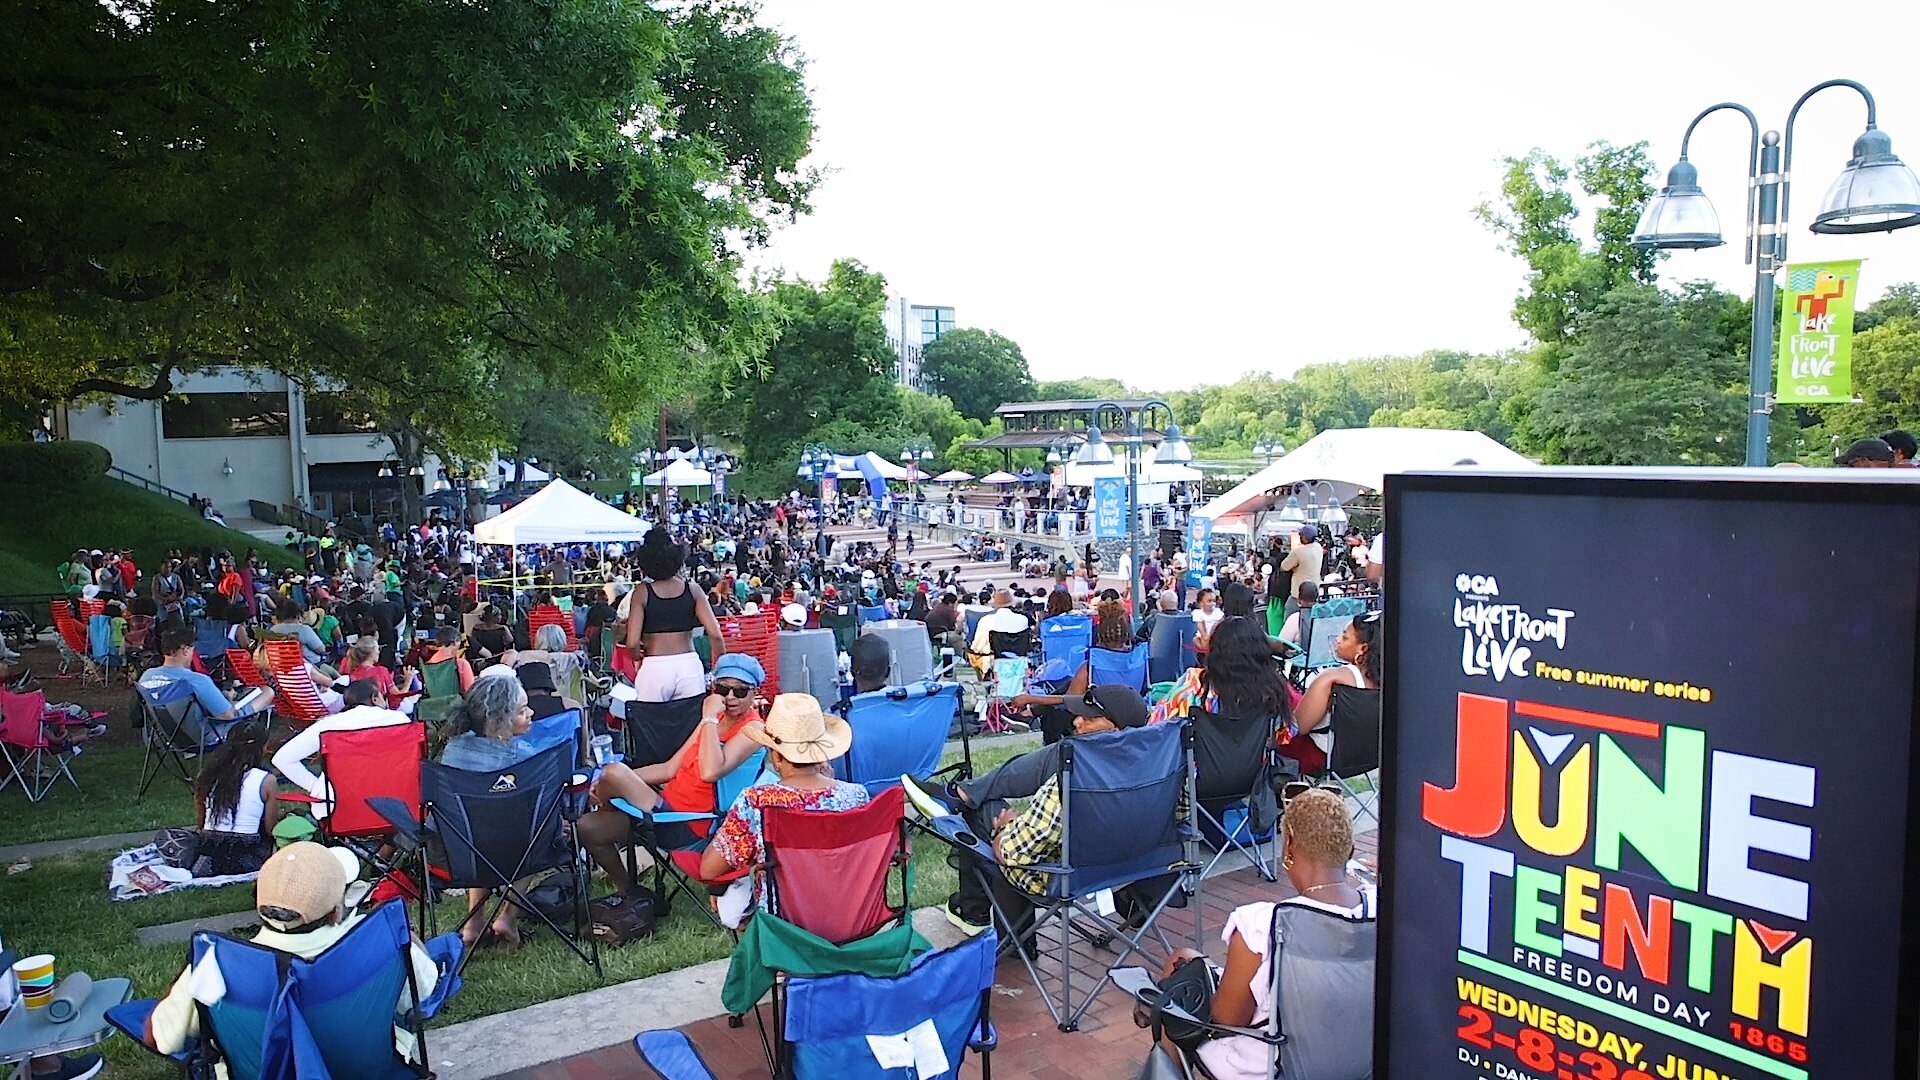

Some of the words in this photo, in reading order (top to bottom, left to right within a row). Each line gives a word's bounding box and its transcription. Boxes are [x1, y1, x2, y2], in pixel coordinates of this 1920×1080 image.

[1536, 661, 1572, 682] Free
[1576, 670, 1650, 693] summer
[1654, 681, 1711, 702] series
[1422, 692, 1816, 921] JUNE
[1441, 835, 1813, 1037] TEENTH
[1457, 977, 1647, 1072] WEDNESDAY,
[1514, 947, 1638, 1004] FREEDOM
[1653, 993, 1711, 1027] DAY
[1457, 1004, 1656, 1080] 2-8:3
[1458, 1047, 1479, 1067] DJ
[1728, 1021, 1807, 1062] 1865
